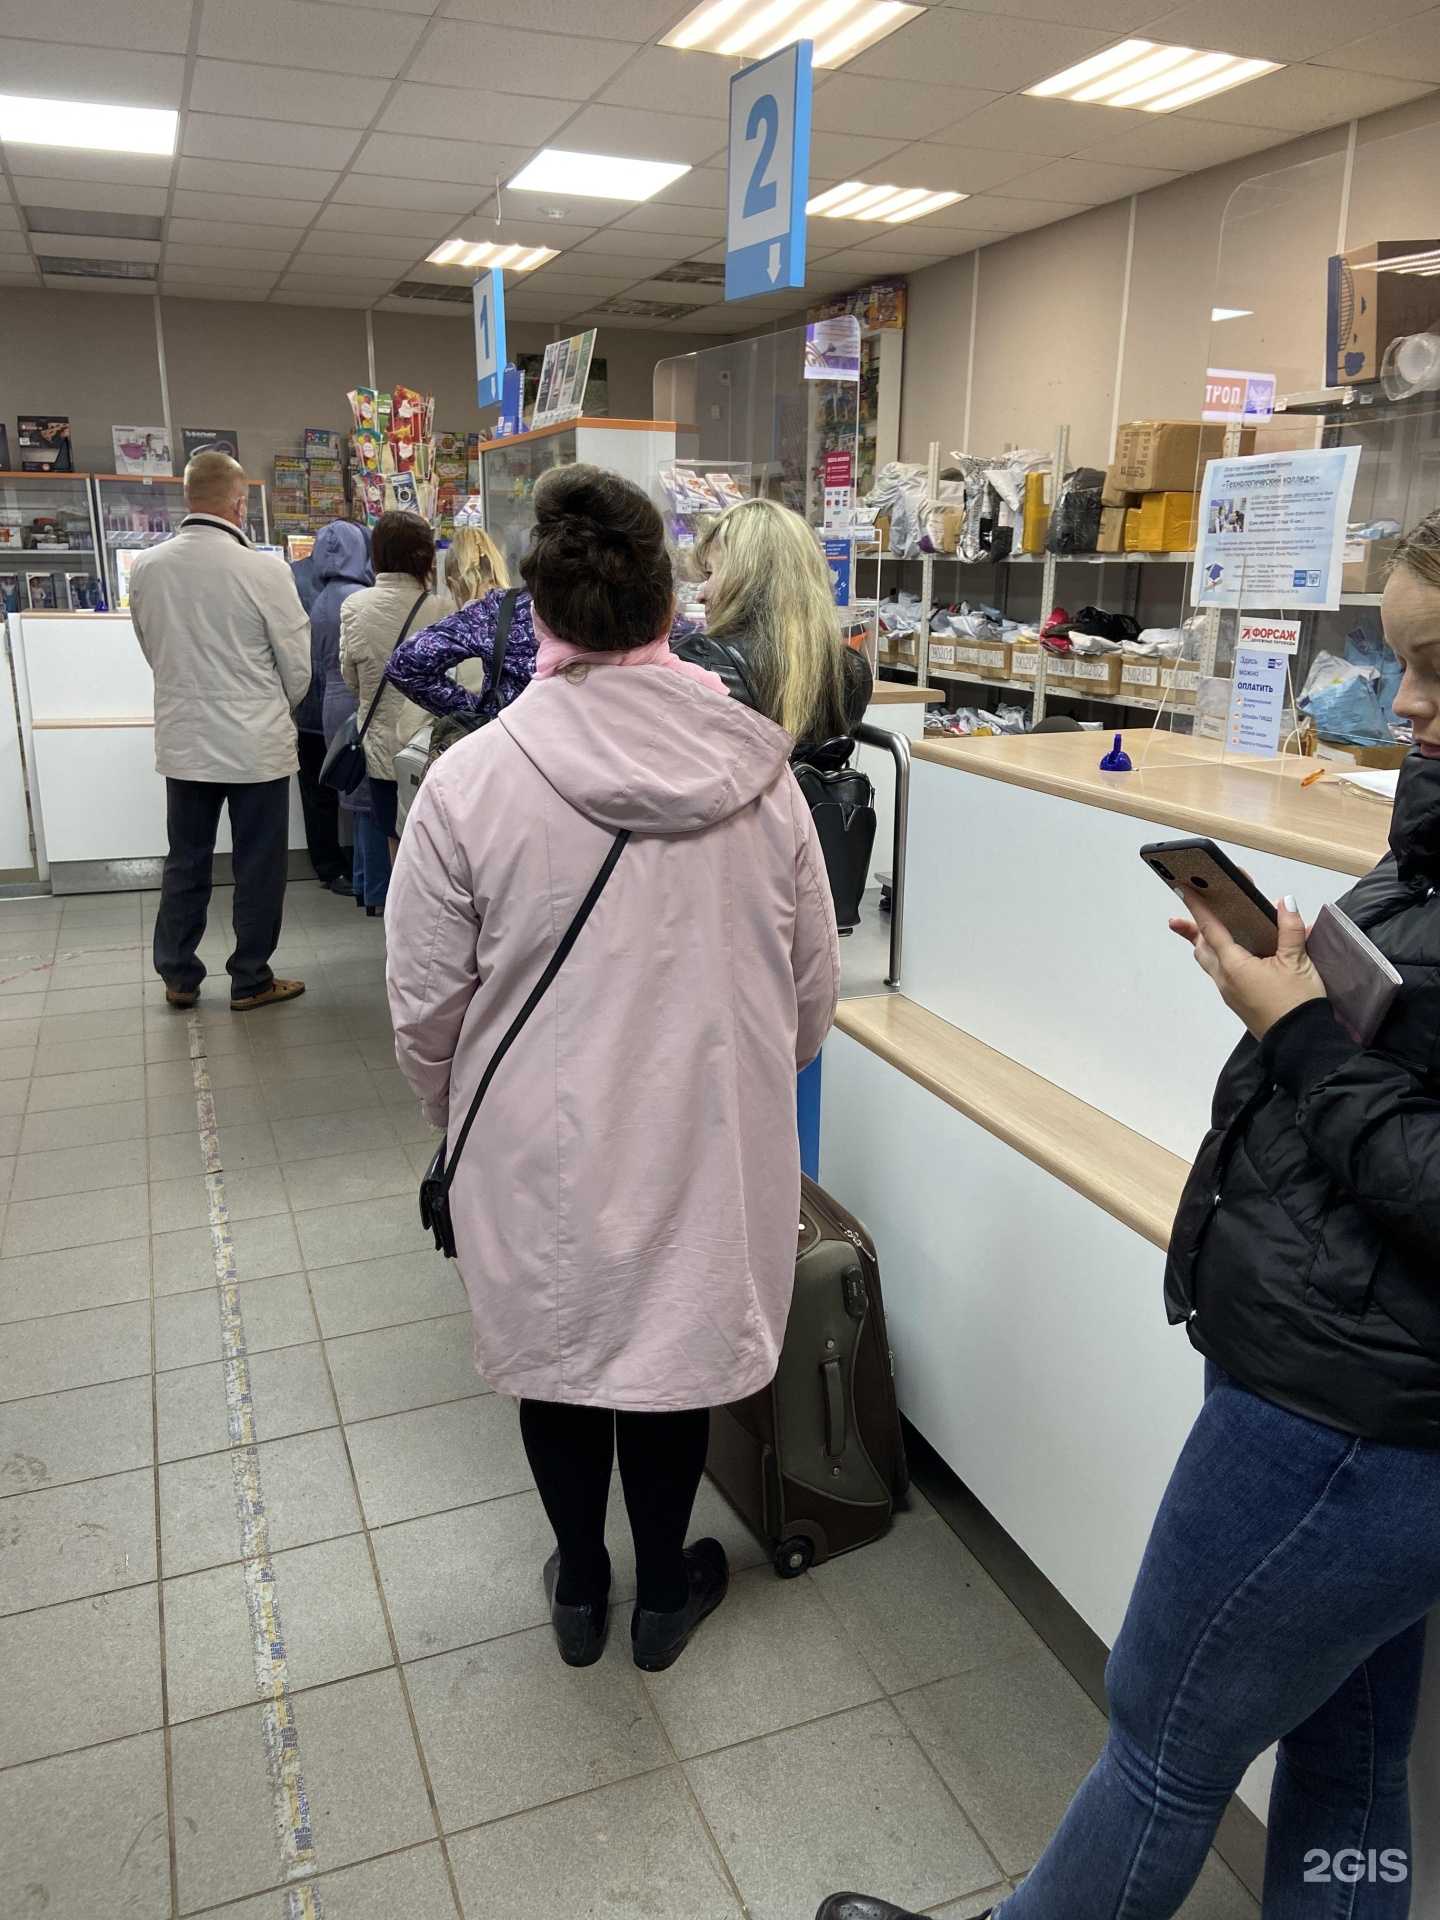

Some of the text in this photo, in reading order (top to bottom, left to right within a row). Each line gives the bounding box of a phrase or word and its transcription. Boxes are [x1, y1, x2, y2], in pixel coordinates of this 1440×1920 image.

[742, 93, 780, 219] 2
[480, 294, 491, 360] 1
[1252, 627, 1297, 641] ФОРСАЖ
[1240, 656, 1258, 665] Здесь
[1237, 682, 1274, 693] ОПЛАТИТЬ
